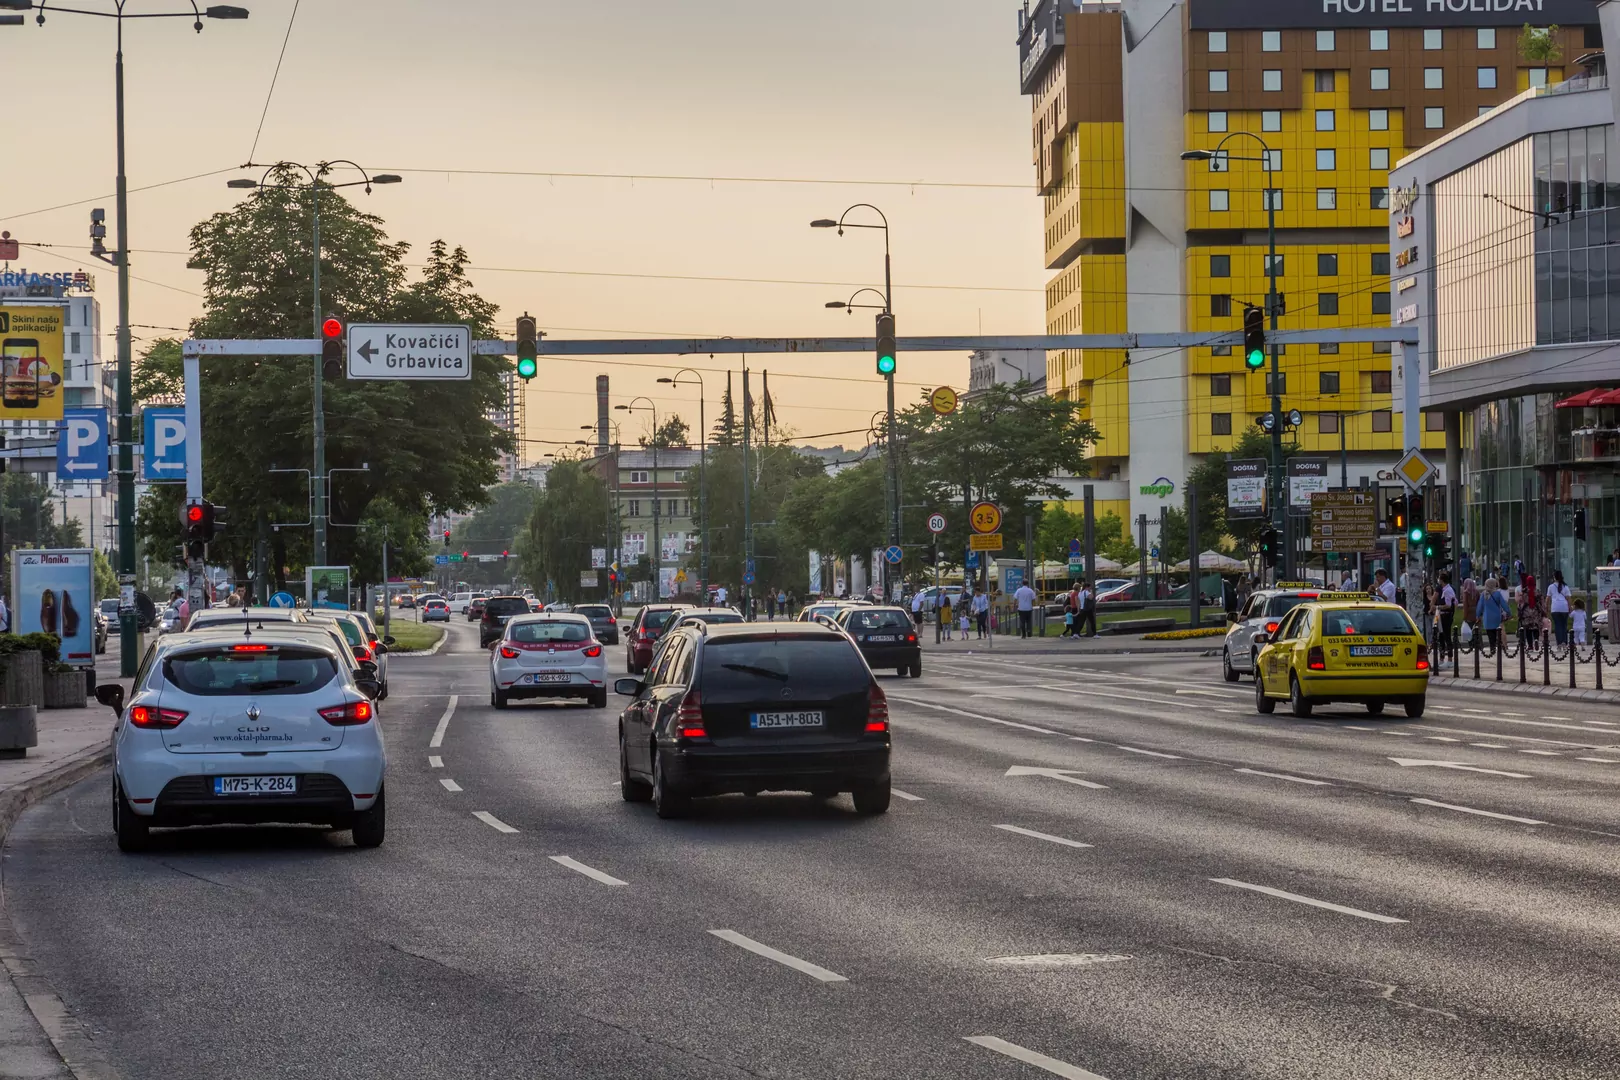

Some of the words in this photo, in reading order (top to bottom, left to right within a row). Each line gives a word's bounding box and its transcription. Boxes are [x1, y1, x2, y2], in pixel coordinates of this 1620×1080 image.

[1323, 0, 1412, 13] HOTEL
[1426, 0, 1545, 12] HOLIDAY
[12, 315, 35, 323] Skini
[37, 315, 59, 323] našu
[12, 324, 56, 333] aplikaciju
[386, 333, 459, 349] Kovačići
[386, 353, 462, 368] Grbavica
[67, 419, 99, 457] P
[154, 419, 186, 456] P
[1140, 485, 1173, 499] mogo
[932, 518, 943, 529] 60
[759, 712, 821, 726] A51-M-803
[213, 733, 293, 744] www.oktal-pharma.ba
[223, 777, 293, 791] M75-K-284
